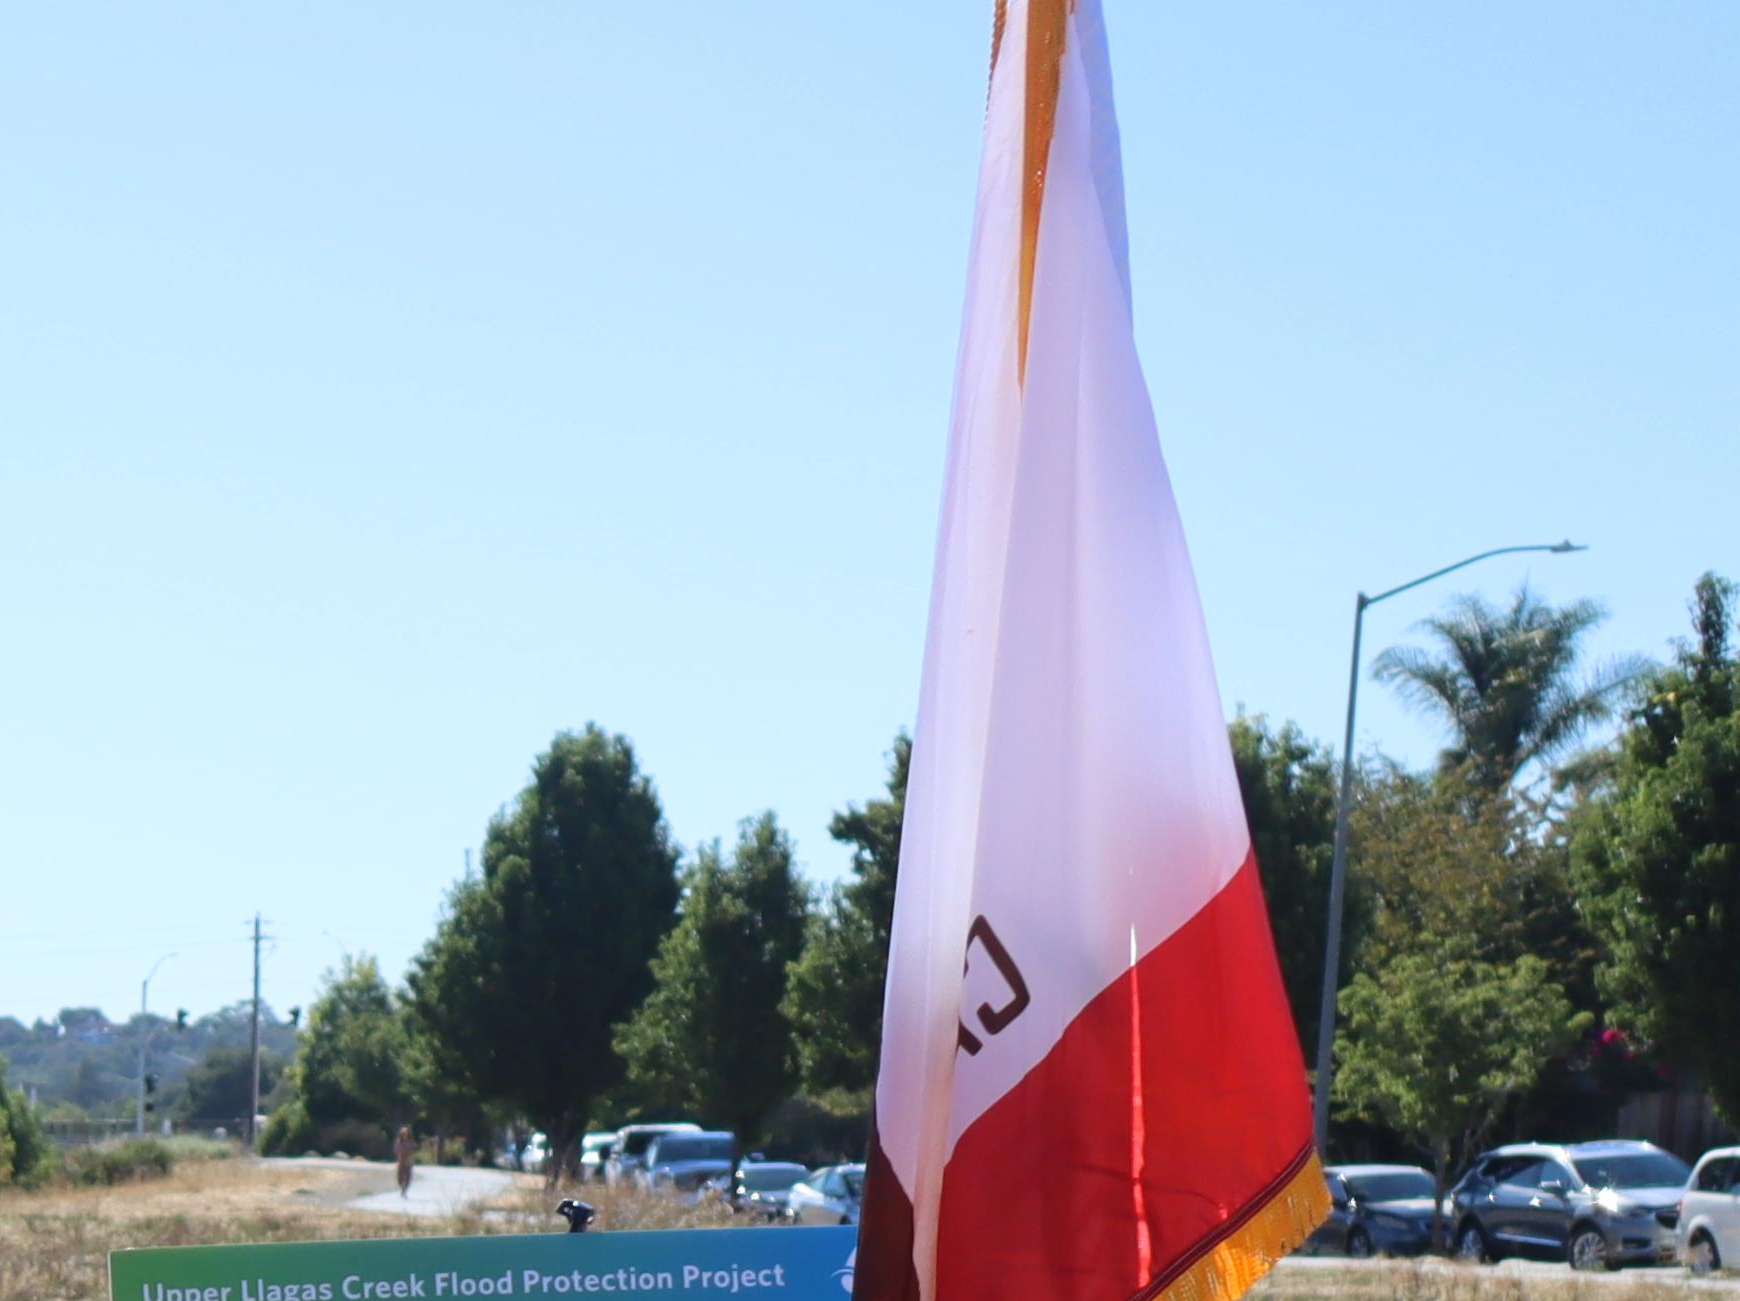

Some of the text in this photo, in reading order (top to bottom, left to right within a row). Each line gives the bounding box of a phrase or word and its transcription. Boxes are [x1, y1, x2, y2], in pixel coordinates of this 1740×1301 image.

[342, 1273, 426, 1299] Creek
[434, 1270, 513, 1297] Flood
[523, 1266, 674, 1294] Protection
[683, 1263, 786, 1292] Project
